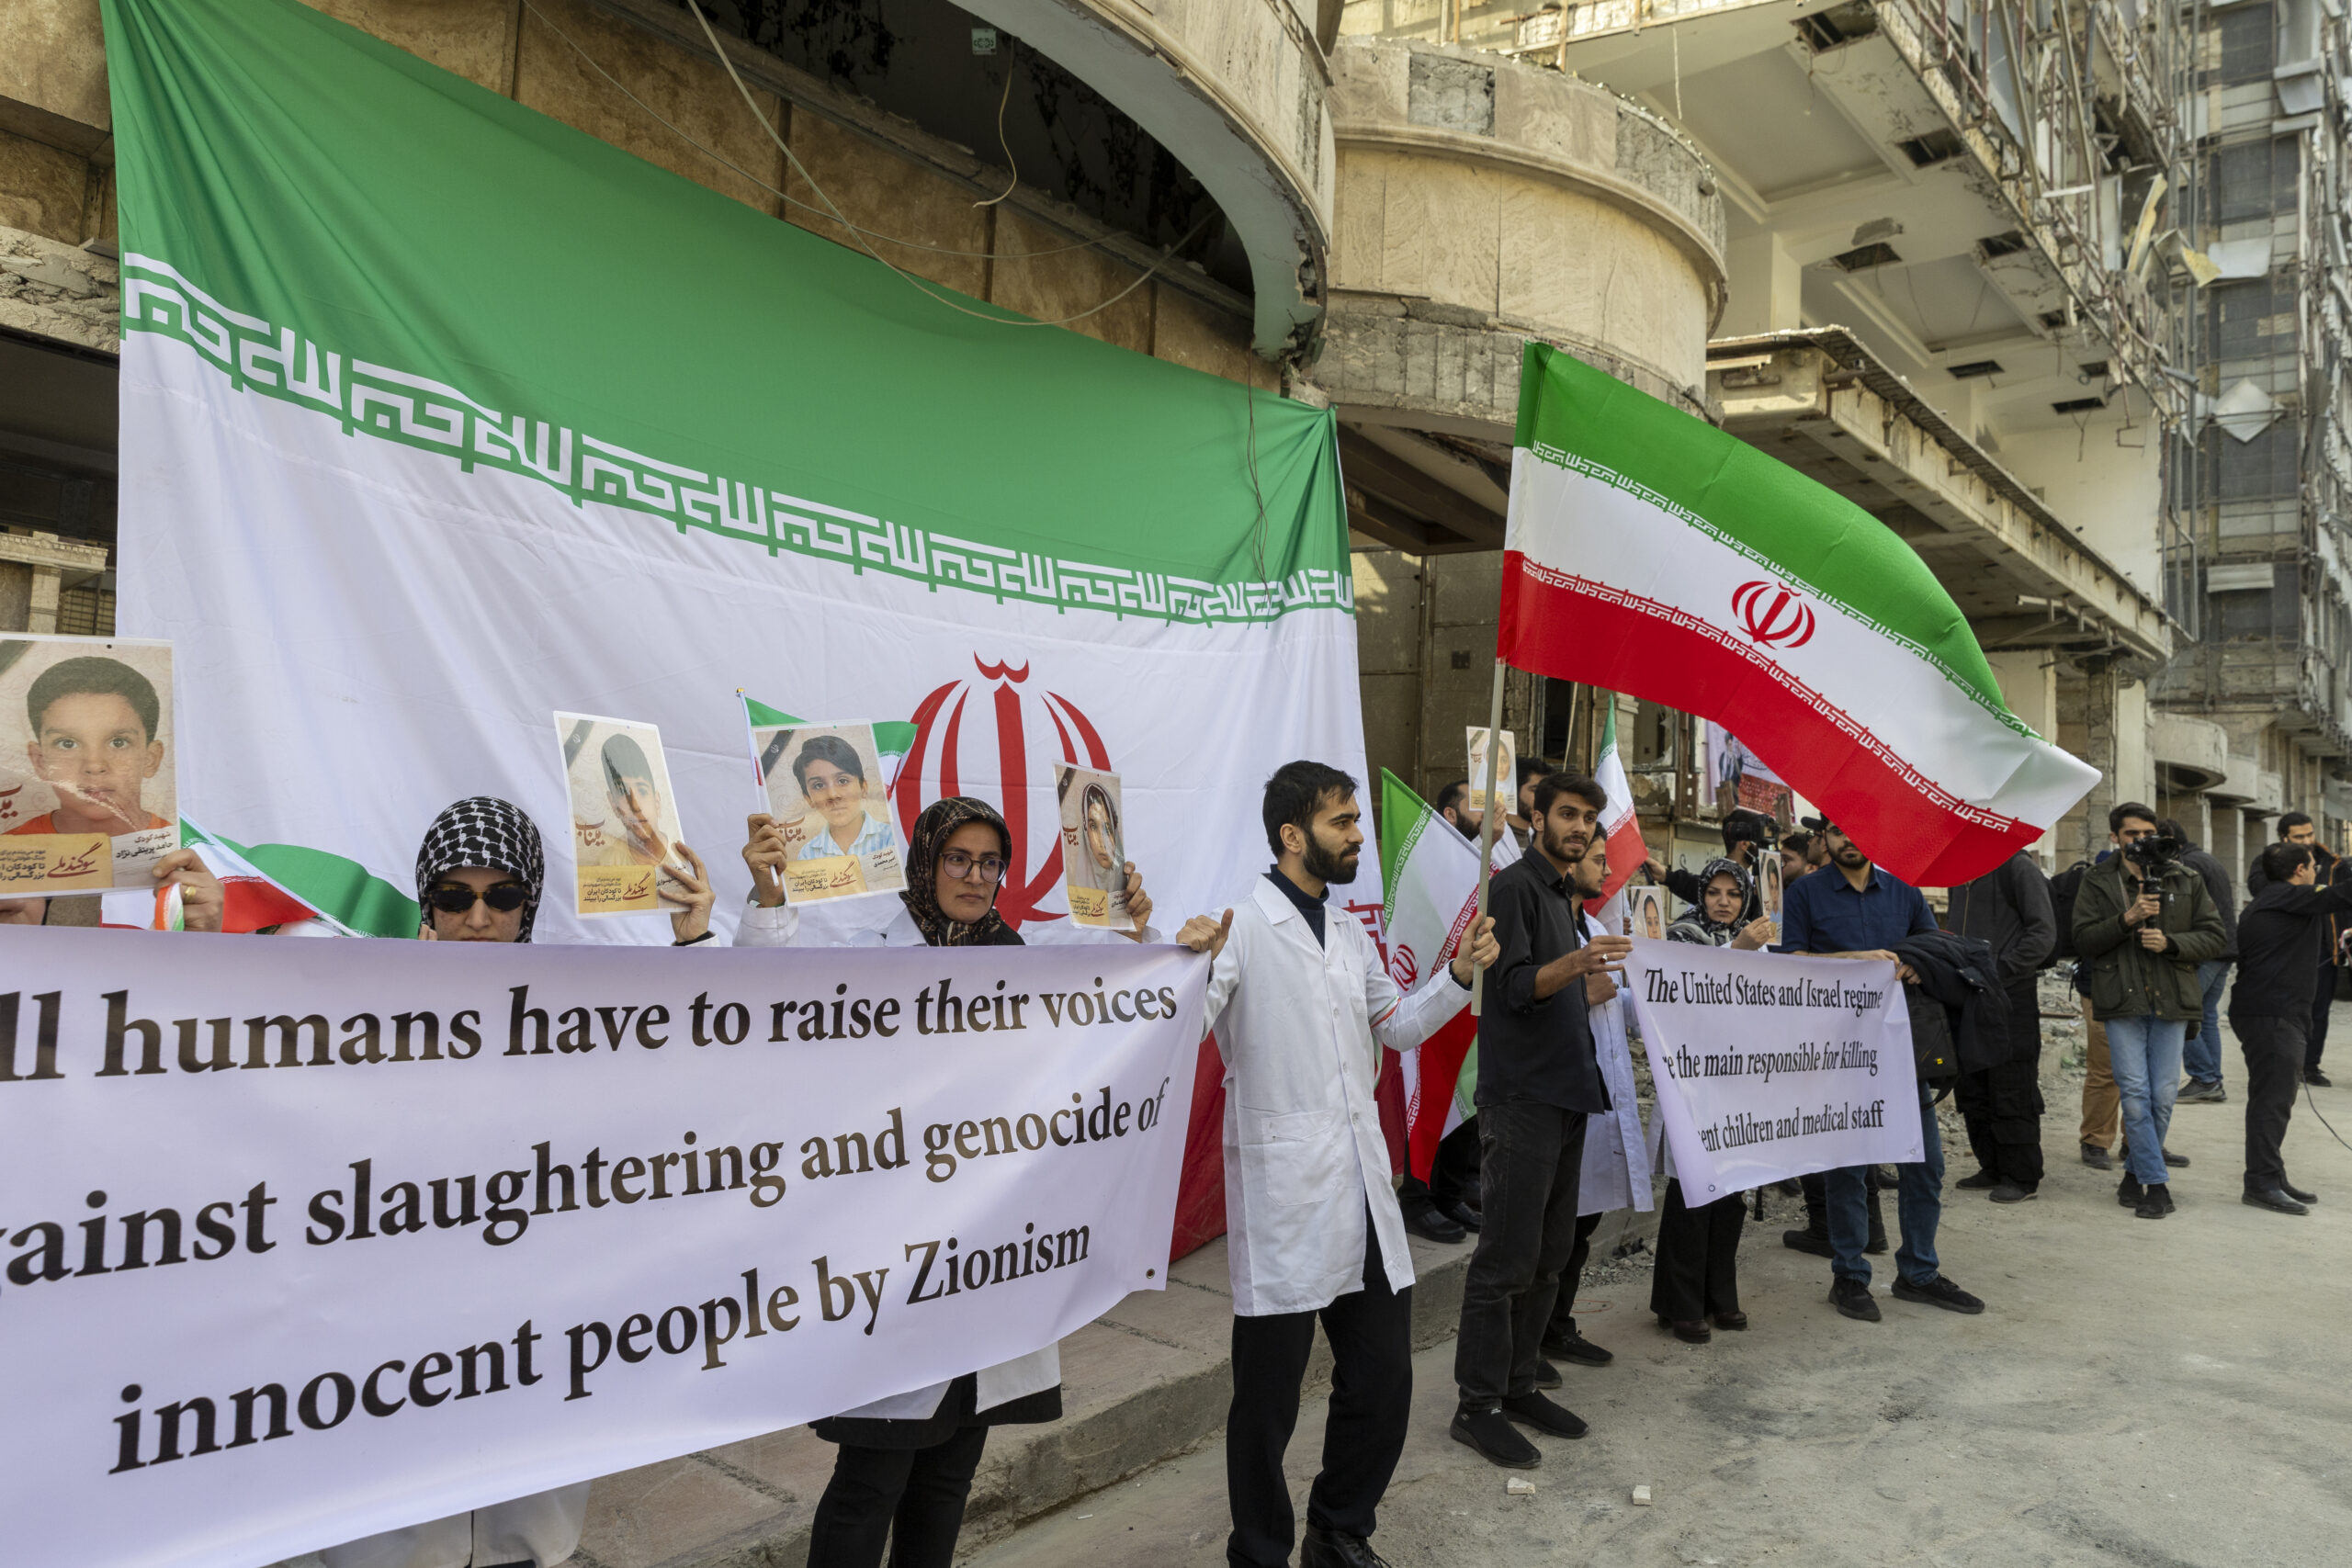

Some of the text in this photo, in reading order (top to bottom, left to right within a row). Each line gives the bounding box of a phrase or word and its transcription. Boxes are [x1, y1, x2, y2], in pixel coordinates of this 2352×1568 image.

[96, 989, 481, 1077] humans
[503, 984, 669, 1056] have
[689, 990, 751, 1047] to
[768, 982, 899, 1042] raise
[915, 977, 1030, 1035] their
[1039, 976, 1177, 1028] voices
[1645, 968, 1883, 1017] The United States and Israel regime
[1677, 1044, 1701, 1078] the
[1703, 1045, 1743, 1077] main
[1746, 1042, 1821, 1083] responsible
[1821, 1040, 1840, 1070] for
[1839, 1040, 1878, 1077] killing
[1698, 1099, 1885, 1152] ent children and medical staff
[0, 1076, 1170, 1287] ainst slaughtering and genocide of
[107, 1222, 1091, 1475] innocent people by Zionism
